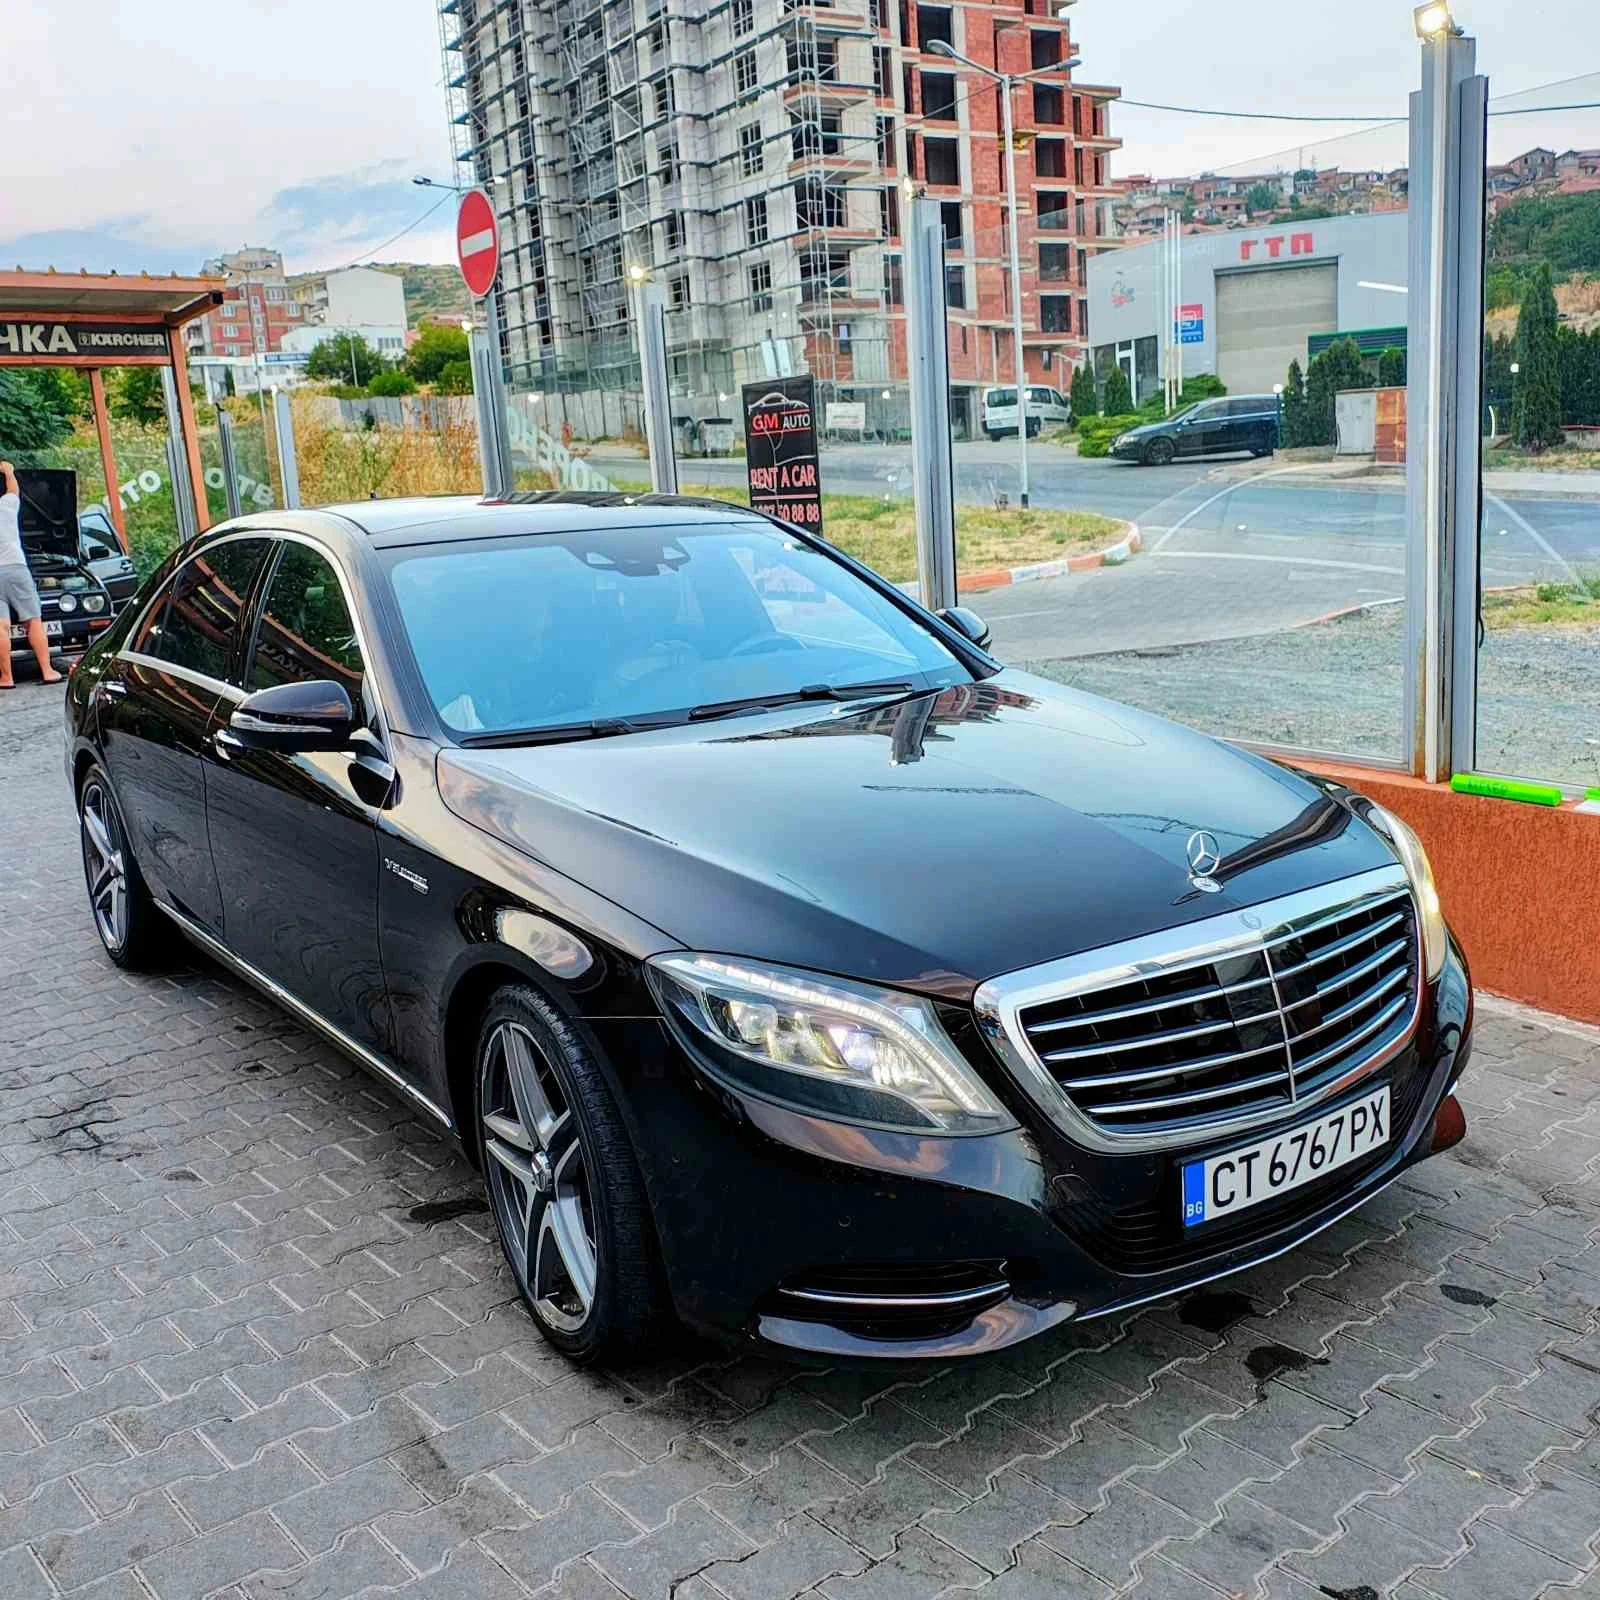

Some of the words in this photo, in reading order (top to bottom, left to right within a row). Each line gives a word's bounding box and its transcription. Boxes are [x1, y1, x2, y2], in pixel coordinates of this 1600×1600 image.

[752, 413, 779, 431] GM
[782, 414, 811, 430] AUTO
[751, 466, 778, 490] RENT
[781, 466, 791, 488] A
[791, 464, 817, 488] CAR
[791, 503, 805, 523] 88
[806, 503, 820, 523] 88
[1212, 1150, 1260, 1208] CT
[1268, 1115, 1345, 1187] 6767
[1350, 1095, 1384, 1152] PX
[1186, 1201, 1203, 1217] BG
